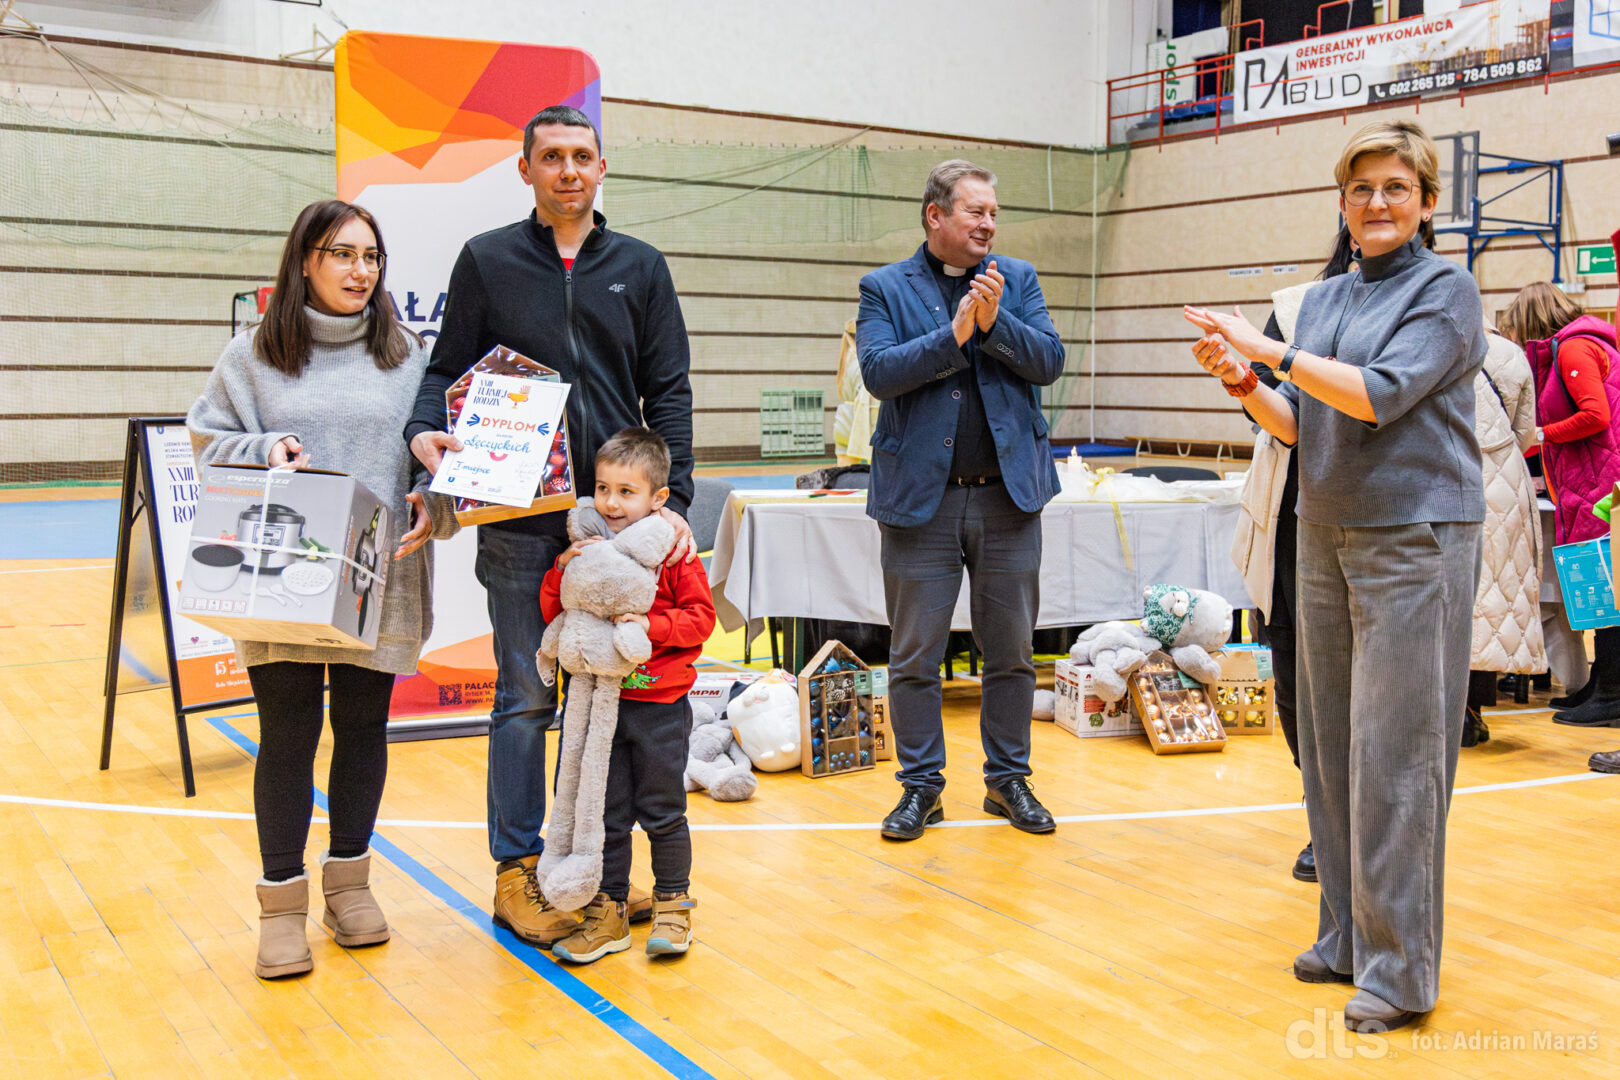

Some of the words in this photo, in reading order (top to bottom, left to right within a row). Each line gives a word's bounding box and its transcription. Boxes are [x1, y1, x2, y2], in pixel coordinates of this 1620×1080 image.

[1295, 34, 1365, 58] GENERALNY
[1366, 18, 1454, 46] WYKONAWCA
[1295, 49, 1365, 72] INWESTYCJI
[1388, 81, 1410, 97] 602
[1411, 76, 1434, 92] 265
[1435, 72, 1456, 88] 125
[1463, 67, 1488, 83] 784
[1491, 62, 1515, 79] 509
[1516, 57, 1543, 74] 862
[608, 283, 626, 293] 4F
[473, 395, 500, 407] RODZIN
[477, 387, 508, 399] TURNIEJ
[481, 417, 537, 433] DYPLOM
[169, 484, 201, 502] TUR
